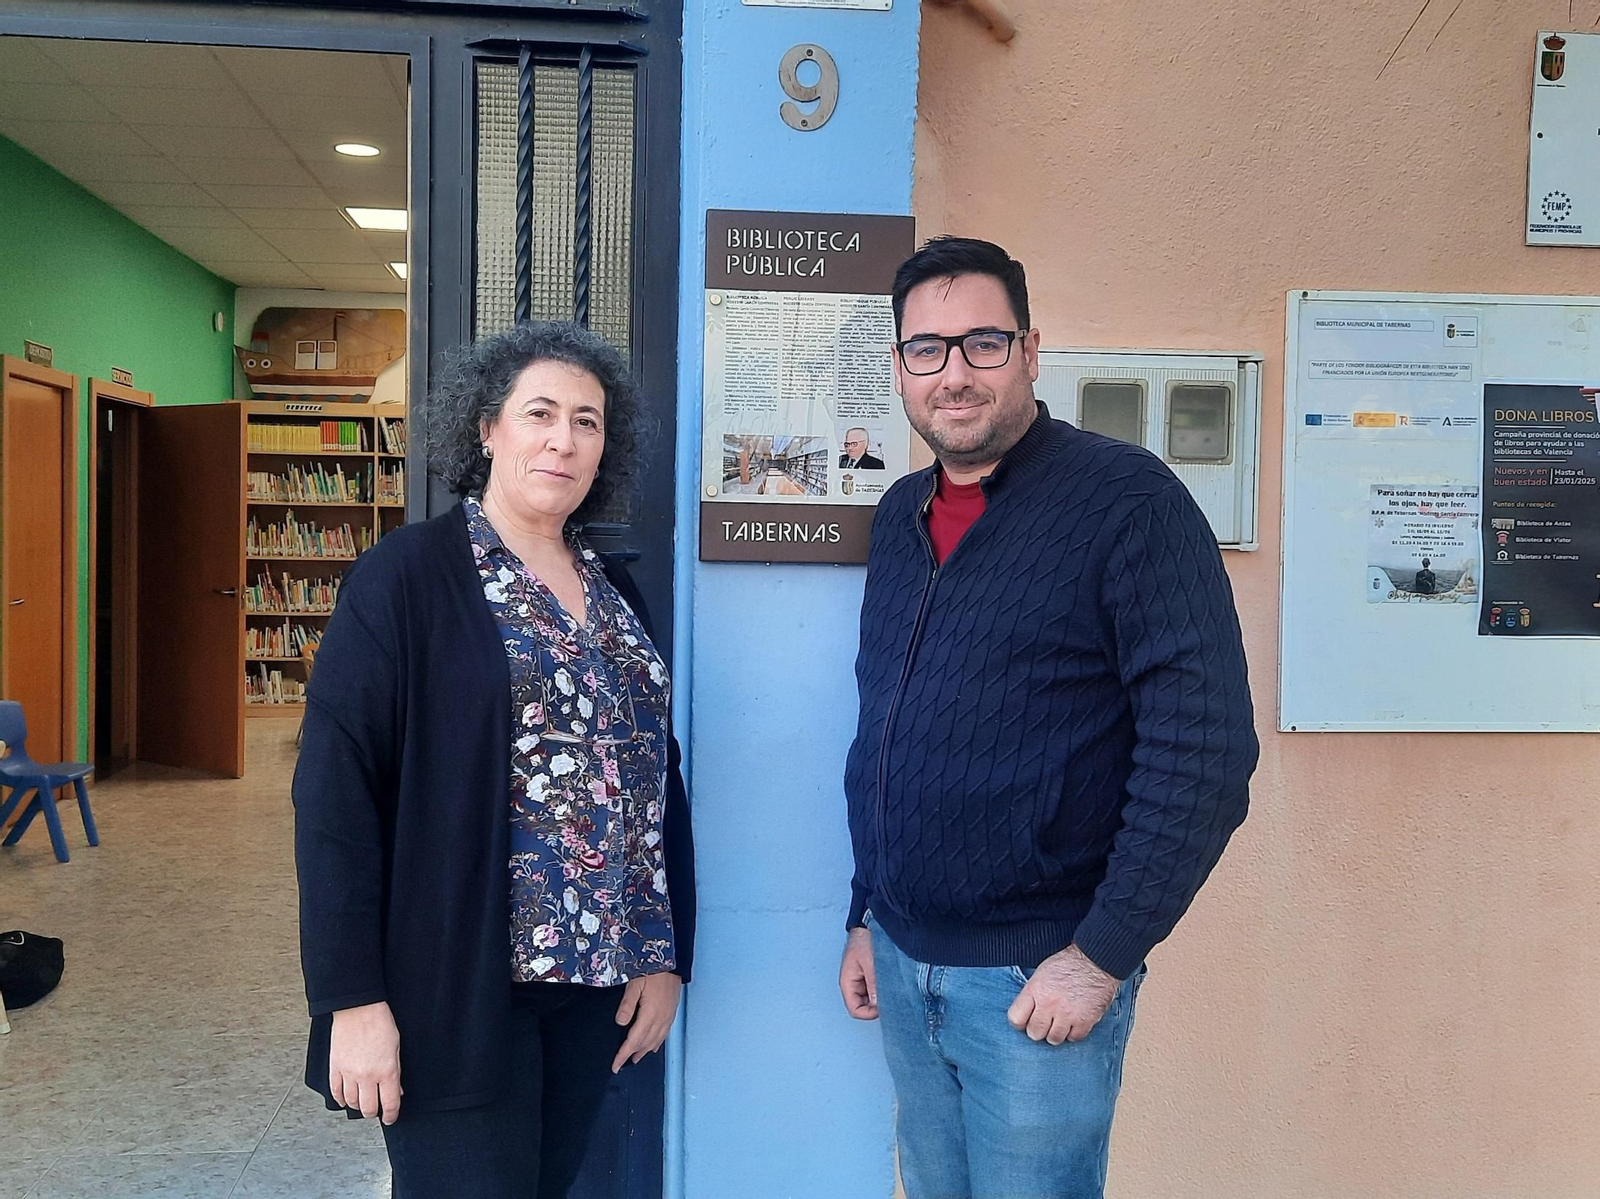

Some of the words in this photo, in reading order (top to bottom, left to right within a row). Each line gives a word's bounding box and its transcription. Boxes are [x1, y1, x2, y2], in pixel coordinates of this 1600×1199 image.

[779, 44, 840, 132] 9
[1547, 202, 1566, 211] FEMP
[727, 228, 860, 252] BIBLIOTECA
[726, 252, 825, 277] PÚBLICA
[1494, 410, 1538, 422] DONA
[1542, 410, 1595, 422] LIBROS
[1494, 430, 1526, 439] Campaña
[722, 521, 841, 543] TABERNAS
